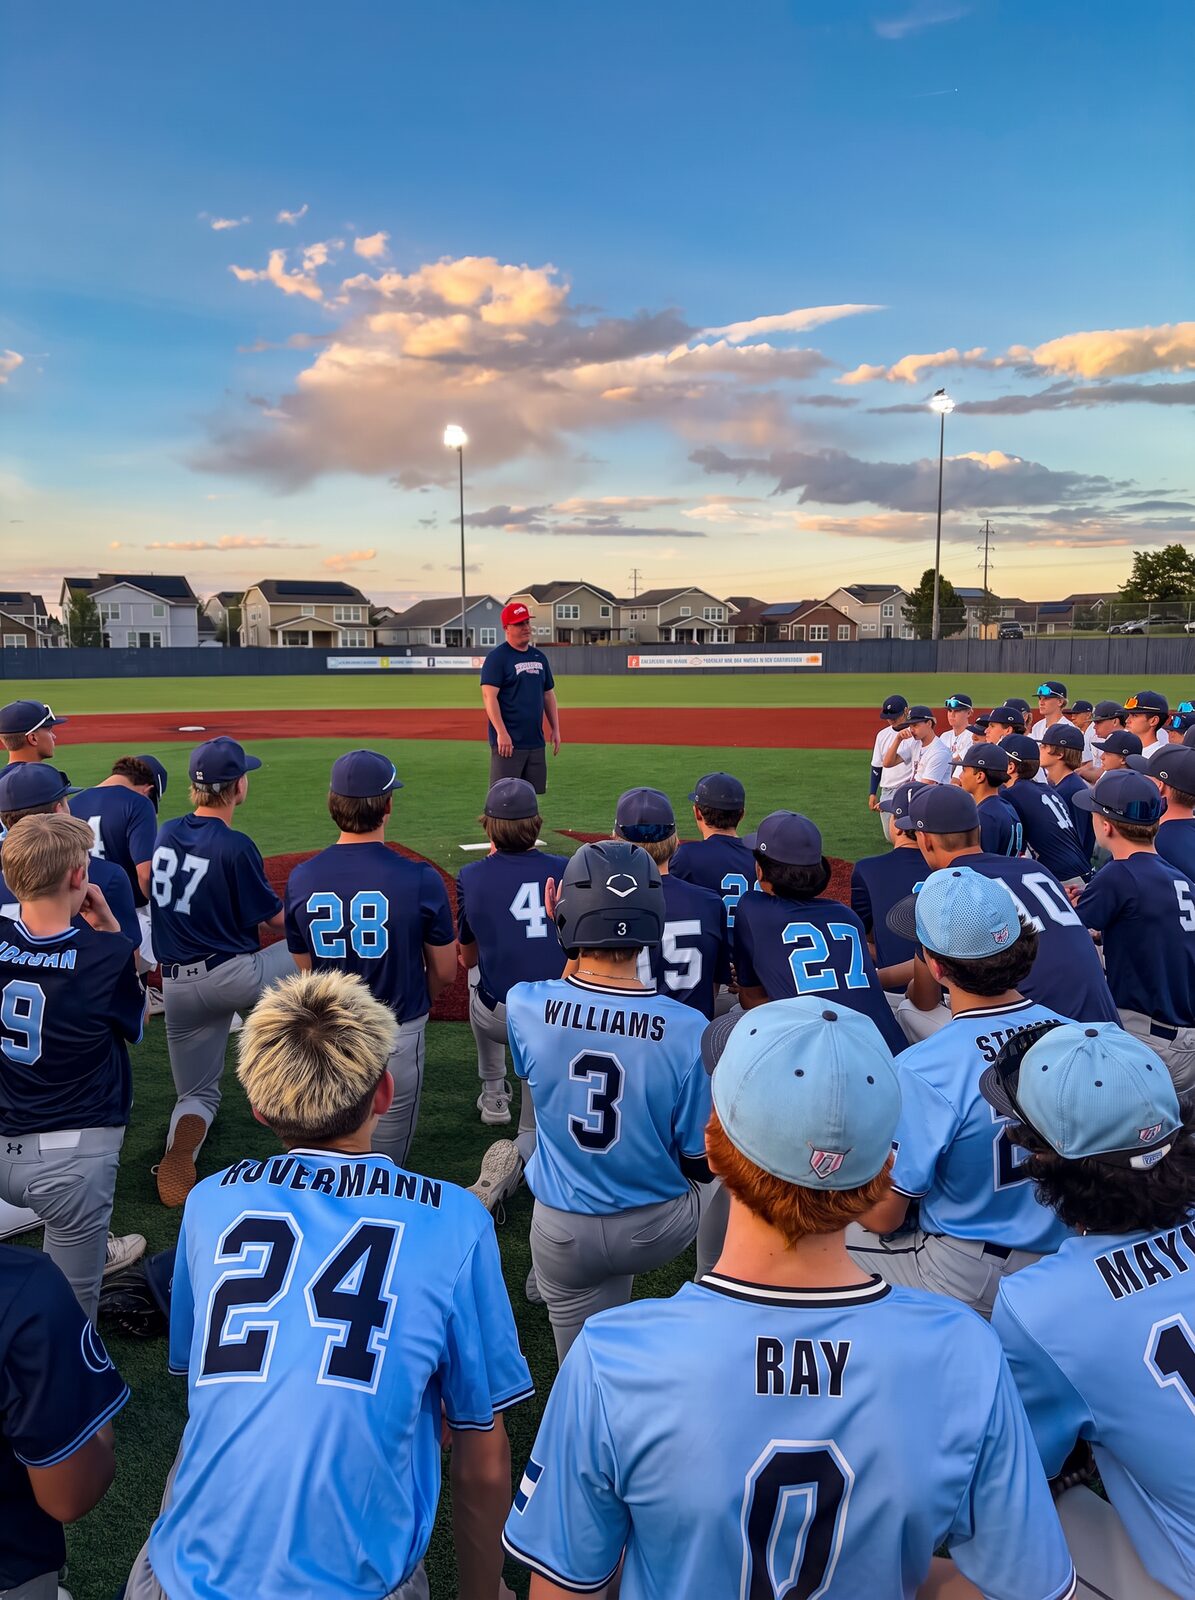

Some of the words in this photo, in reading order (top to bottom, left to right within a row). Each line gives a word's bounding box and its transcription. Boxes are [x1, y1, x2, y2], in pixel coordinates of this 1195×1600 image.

[151, 845, 210, 915] 87
[509, 881, 547, 939] 4
[721, 873, 763, 928] 2
[306, 890, 389, 959] 28
[617, 922, 627, 936] 3
[781, 922, 870, 995] 27
[0, 979, 46, 1065] 9
[544, 999, 666, 1042] WILLIAMS
[568, 1049, 625, 1155] 3
[195, 1210, 404, 1395] 24
[755, 1335, 852, 1398] RAY
[739, 1438, 856, 1600] 0
